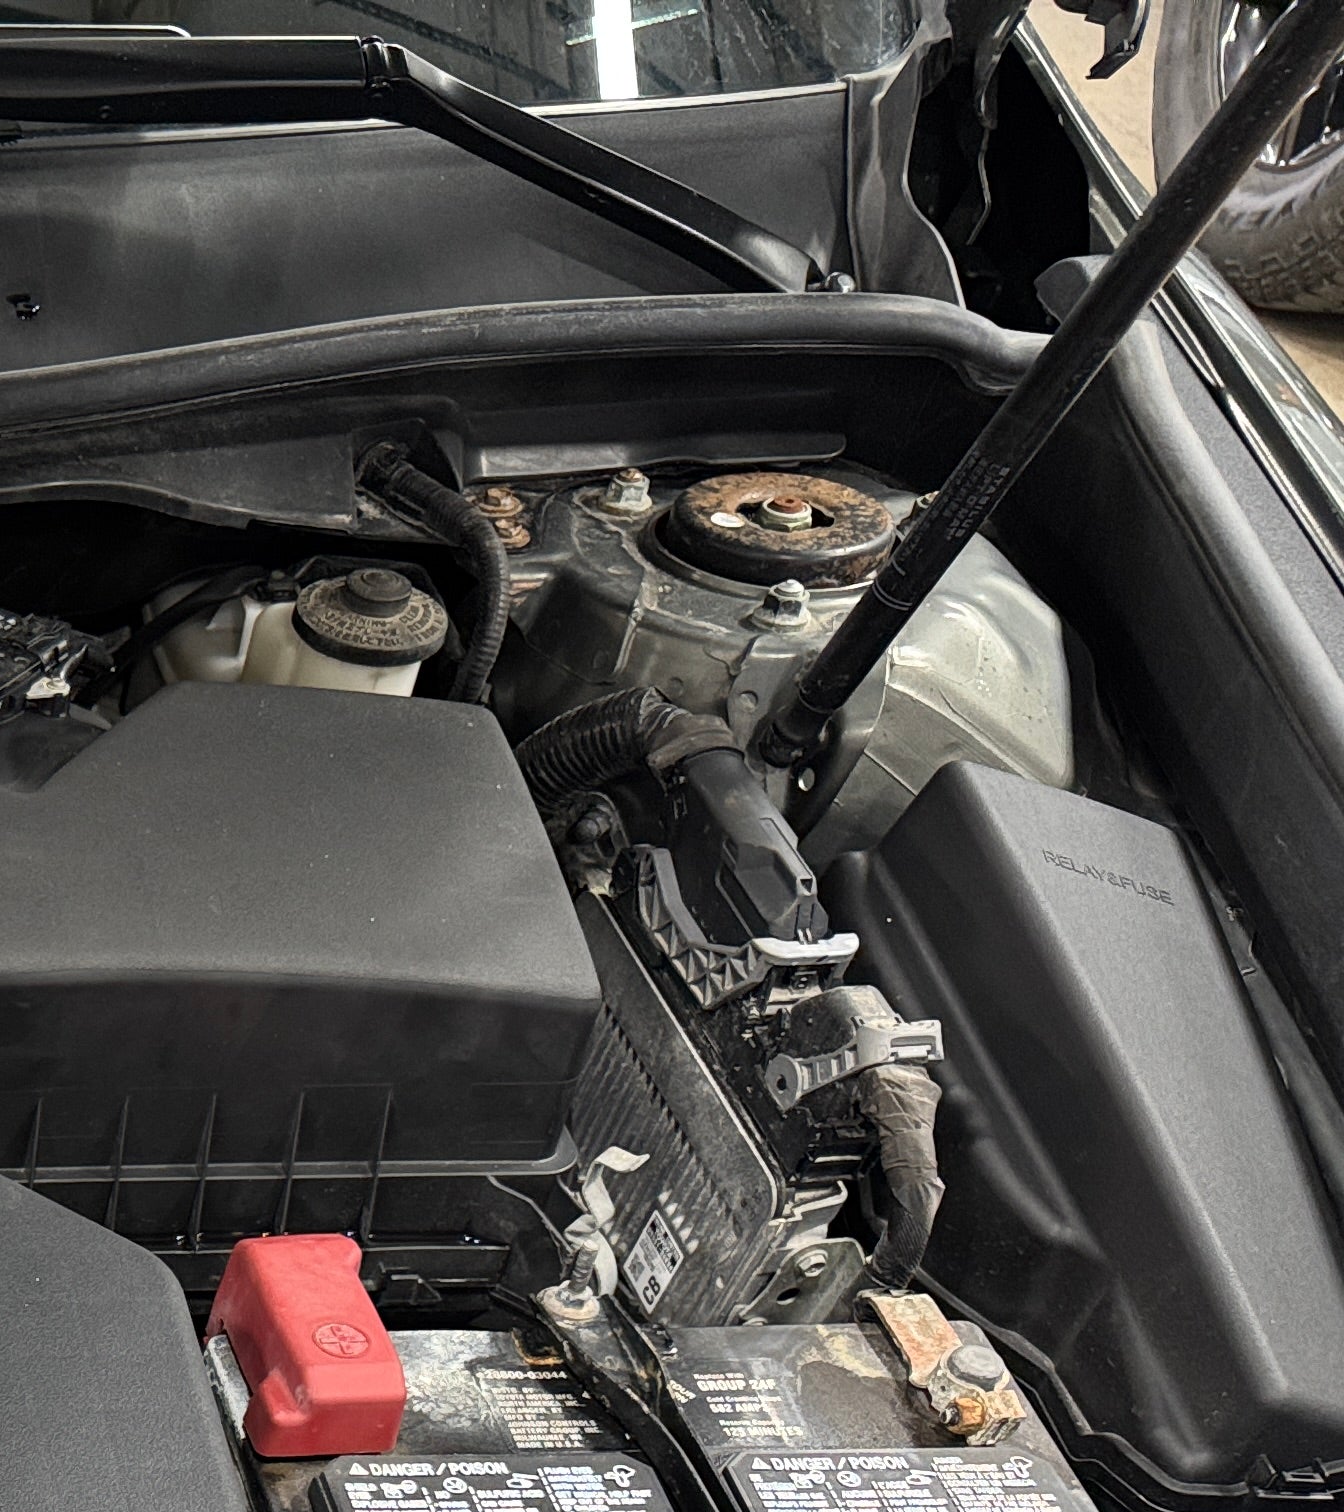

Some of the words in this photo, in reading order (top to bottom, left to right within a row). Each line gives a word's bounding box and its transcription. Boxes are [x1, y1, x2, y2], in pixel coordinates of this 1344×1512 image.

[1042, 849, 1175, 906] RELAY&FUSE
[643, 1274, 660, 1305] CB
[696, 1380, 746, 1392] GROUP
[749, 1378, 776, 1390] 24F
[747, 1426, 804, 1436] MINUTES
[369, 1462, 435, 1477] DANGER
[447, 1462, 510, 1476] POISON
[770, 1457, 837, 1471] DANGER
[847, 1456, 910, 1470] POISON
